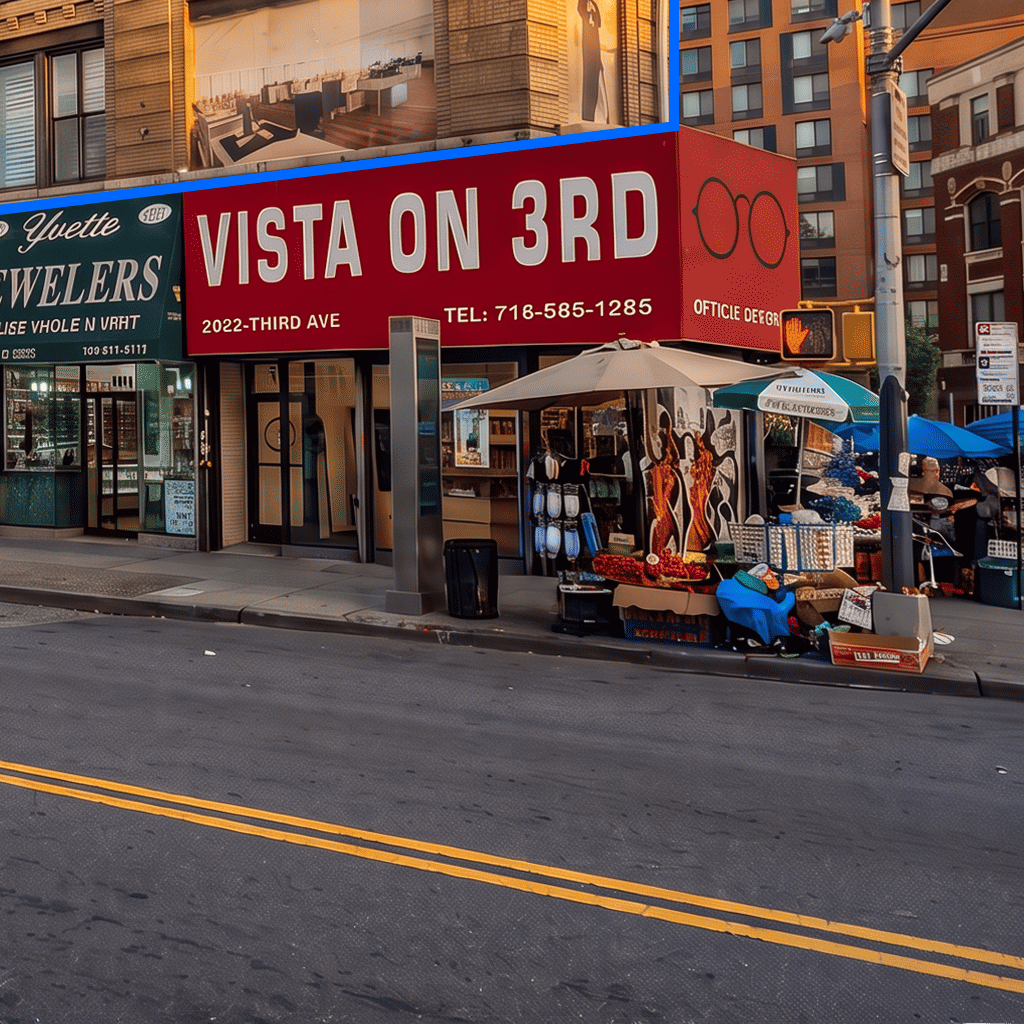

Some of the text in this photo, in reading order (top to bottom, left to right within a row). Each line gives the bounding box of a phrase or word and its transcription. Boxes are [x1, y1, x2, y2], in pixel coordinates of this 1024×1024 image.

[17, 210, 121, 254] Yvette
[196, 170, 660, 288] VISTA ON 3RD
[201, 314, 302, 334] 2022-THIRD
[306, 313, 341, 330] AVE
[443, 306, 488, 323] TEL:
